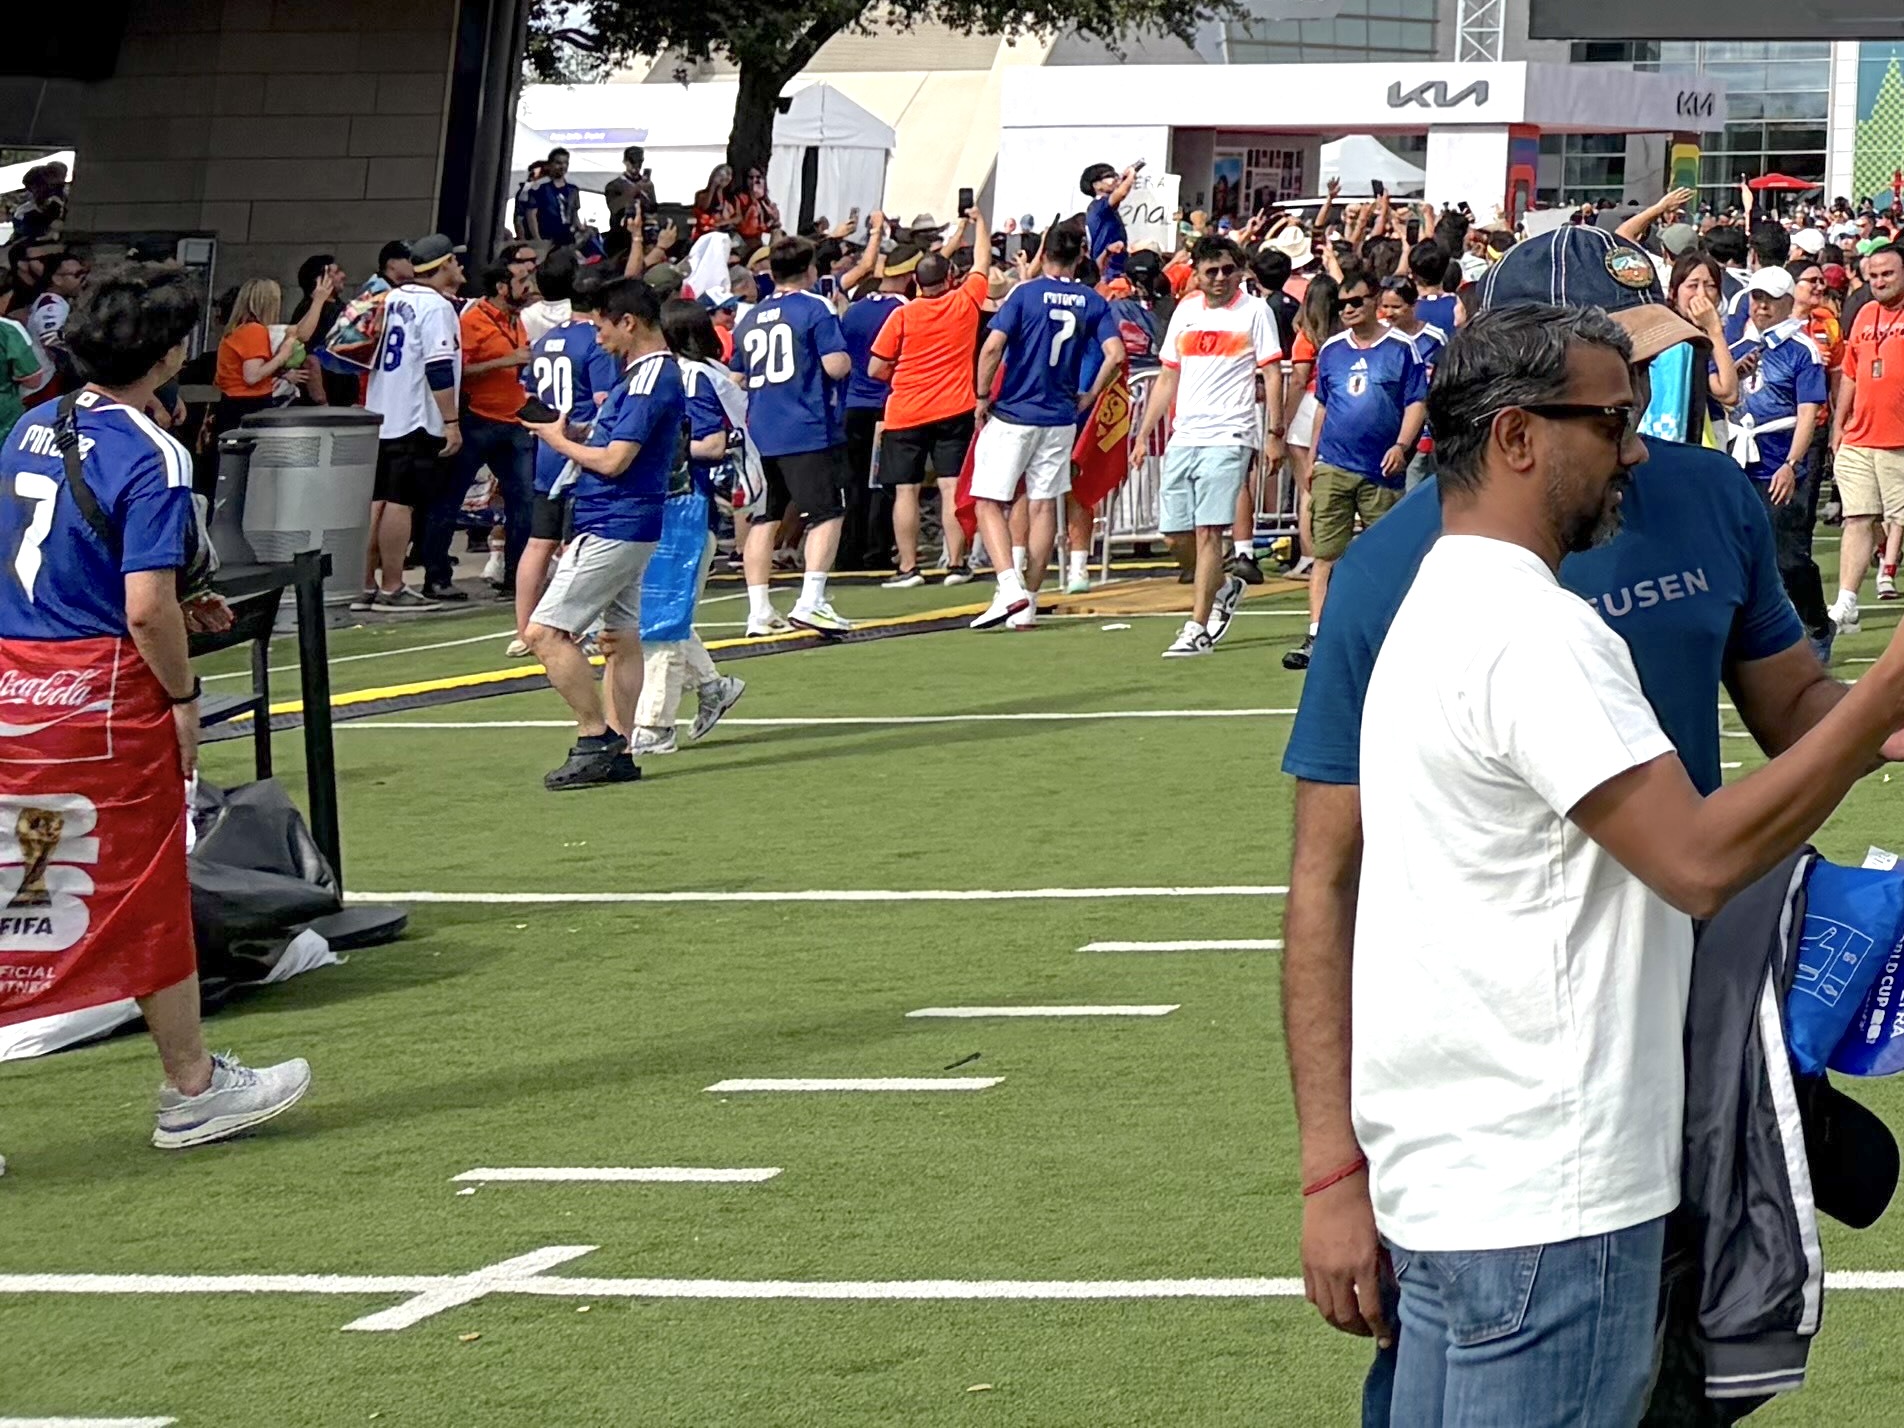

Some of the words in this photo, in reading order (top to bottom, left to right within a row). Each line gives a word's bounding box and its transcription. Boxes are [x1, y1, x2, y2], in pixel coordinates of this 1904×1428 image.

[743, 323, 795, 389] 20
[1048, 308, 1077, 367] 7
[533, 355, 573, 414] 20
[14, 471, 59, 604] 7
[1586, 568, 1709, 617] USEN
[0, 917, 53, 935] FIFA
